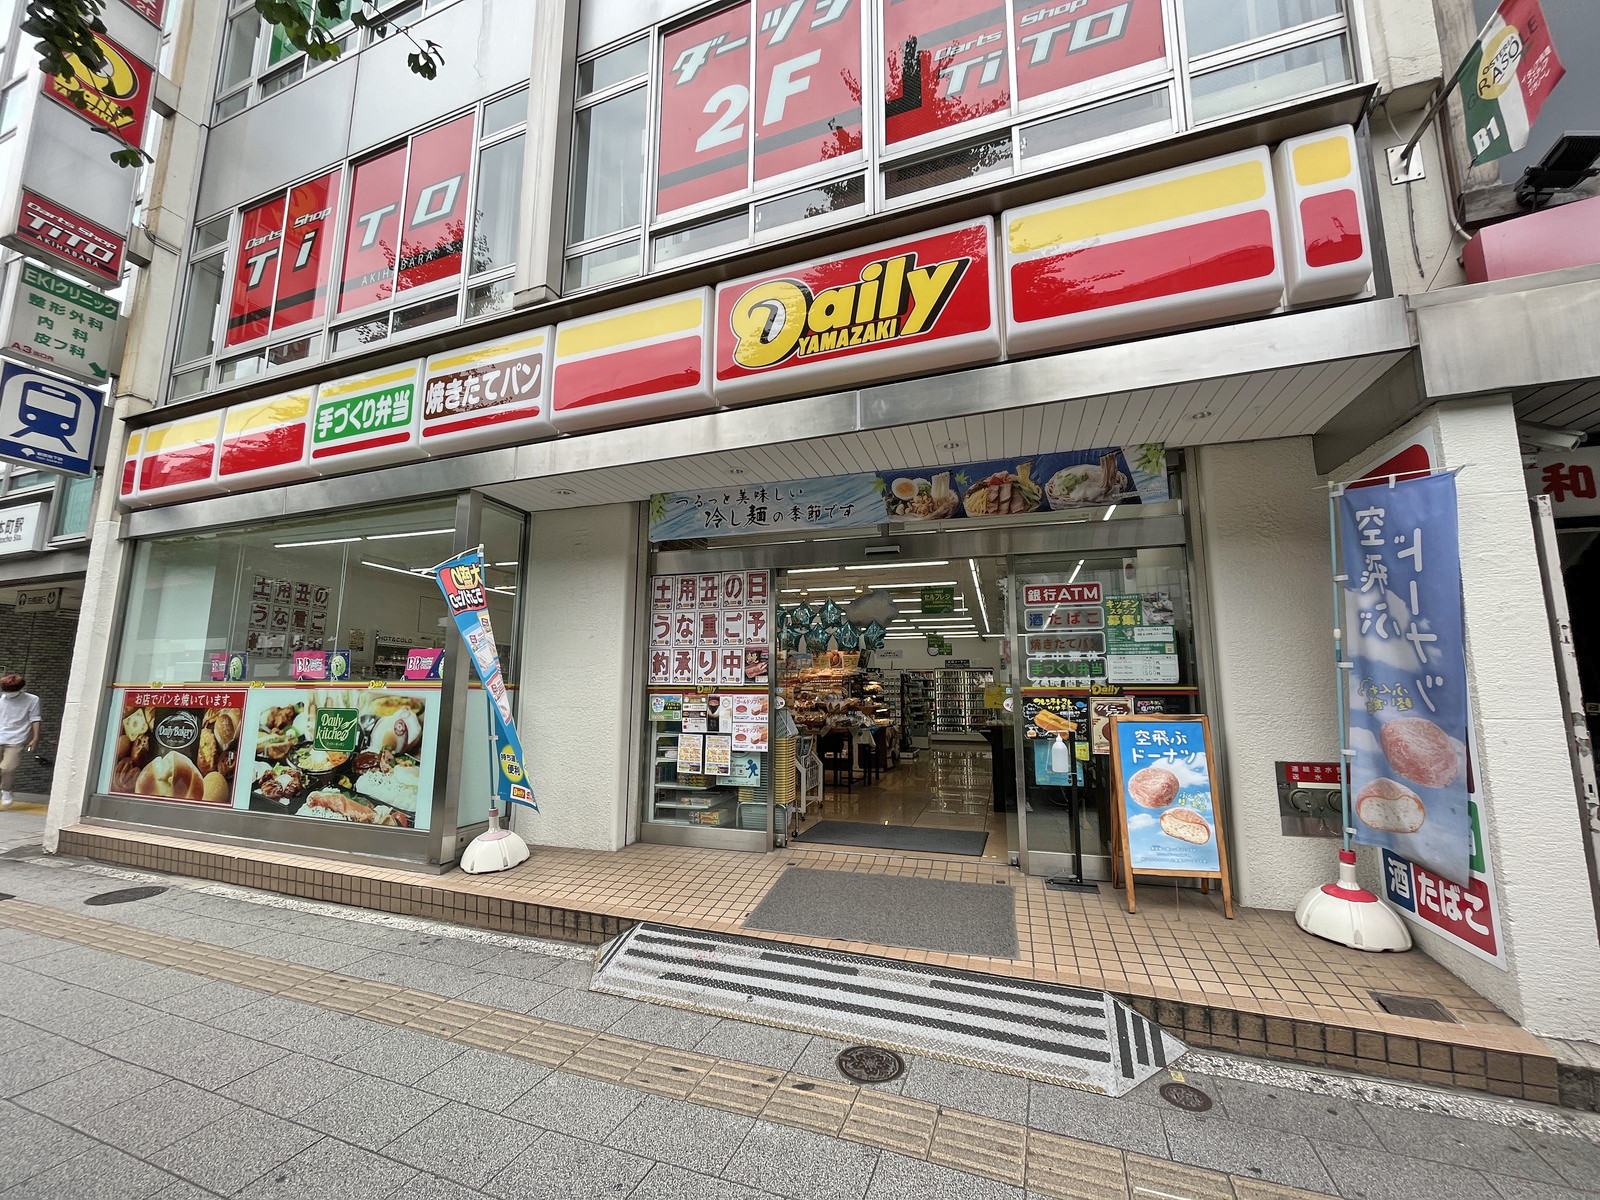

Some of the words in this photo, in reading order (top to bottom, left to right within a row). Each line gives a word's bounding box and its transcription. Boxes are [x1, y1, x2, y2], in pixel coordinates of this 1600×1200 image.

[1020, 0, 1088, 27] Shop
[933, 29, 1003, 62] Darts
[695, 48, 823, 153] 2F
[1472, 116, 1501, 156] B1
[26, 201, 76, 230] Darts
[77, 226, 118, 251] Shop
[244, 229, 283, 251] Darts
[293, 206, 333, 229] Shop
[36, 235, 100, 268] AKIHABARA
[360, 251, 434, 286] AKIHBARA
[23, 266, 118, 316] EKIクリニック
[27, 291, 105, 333] 整形外科
[731, 252, 974, 369] Daily
[33, 331, 86, 360] 皮フ科
[797, 318, 898, 357] YAMAZAKI
[424, 360, 542, 416] 焼きたてパン
[316, 387, 412, 440] 手づくり弁当
[1541, 462, 1597, 503] 和
[674, 487, 805, 509] つるっと美味しい
[703, 503, 856, 530] 冷し麺の季節です
[654, 571, 768, 603] 土用丑の日
[924, 592, 951, 601] セルフレジ
[1027, 586, 1099, 602] 銀行ATM
[1106, 599, 1140, 609] キッチン
[1110, 607, 1137, 615] スタッフ
[654, 611, 767, 640] うな重ご予
[1029, 612, 1044, 627] 酒
[1049, 612, 1101, 626] たばこ
[652, 650, 742, 677] 約承り中
[1031, 662, 1103, 676] 手づくり弁当
[134, 692, 235, 707] お店でパンを焼いています。
[696, 685, 718, 694] Daily
[1091, 684, 1121, 696] Daily
[158, 725, 173, 739] Daily
[173, 725, 193, 740] Bakery
[320, 713, 344, 731] Daily
[1134, 729, 1189, 747] 空飛ぶ
[499, 753, 519, 764] 持ち運
[1132, 747, 1197, 765] ドーナツ
[1388, 857, 1411, 899] 酒
[1417, 871, 1490, 936] たばこ
